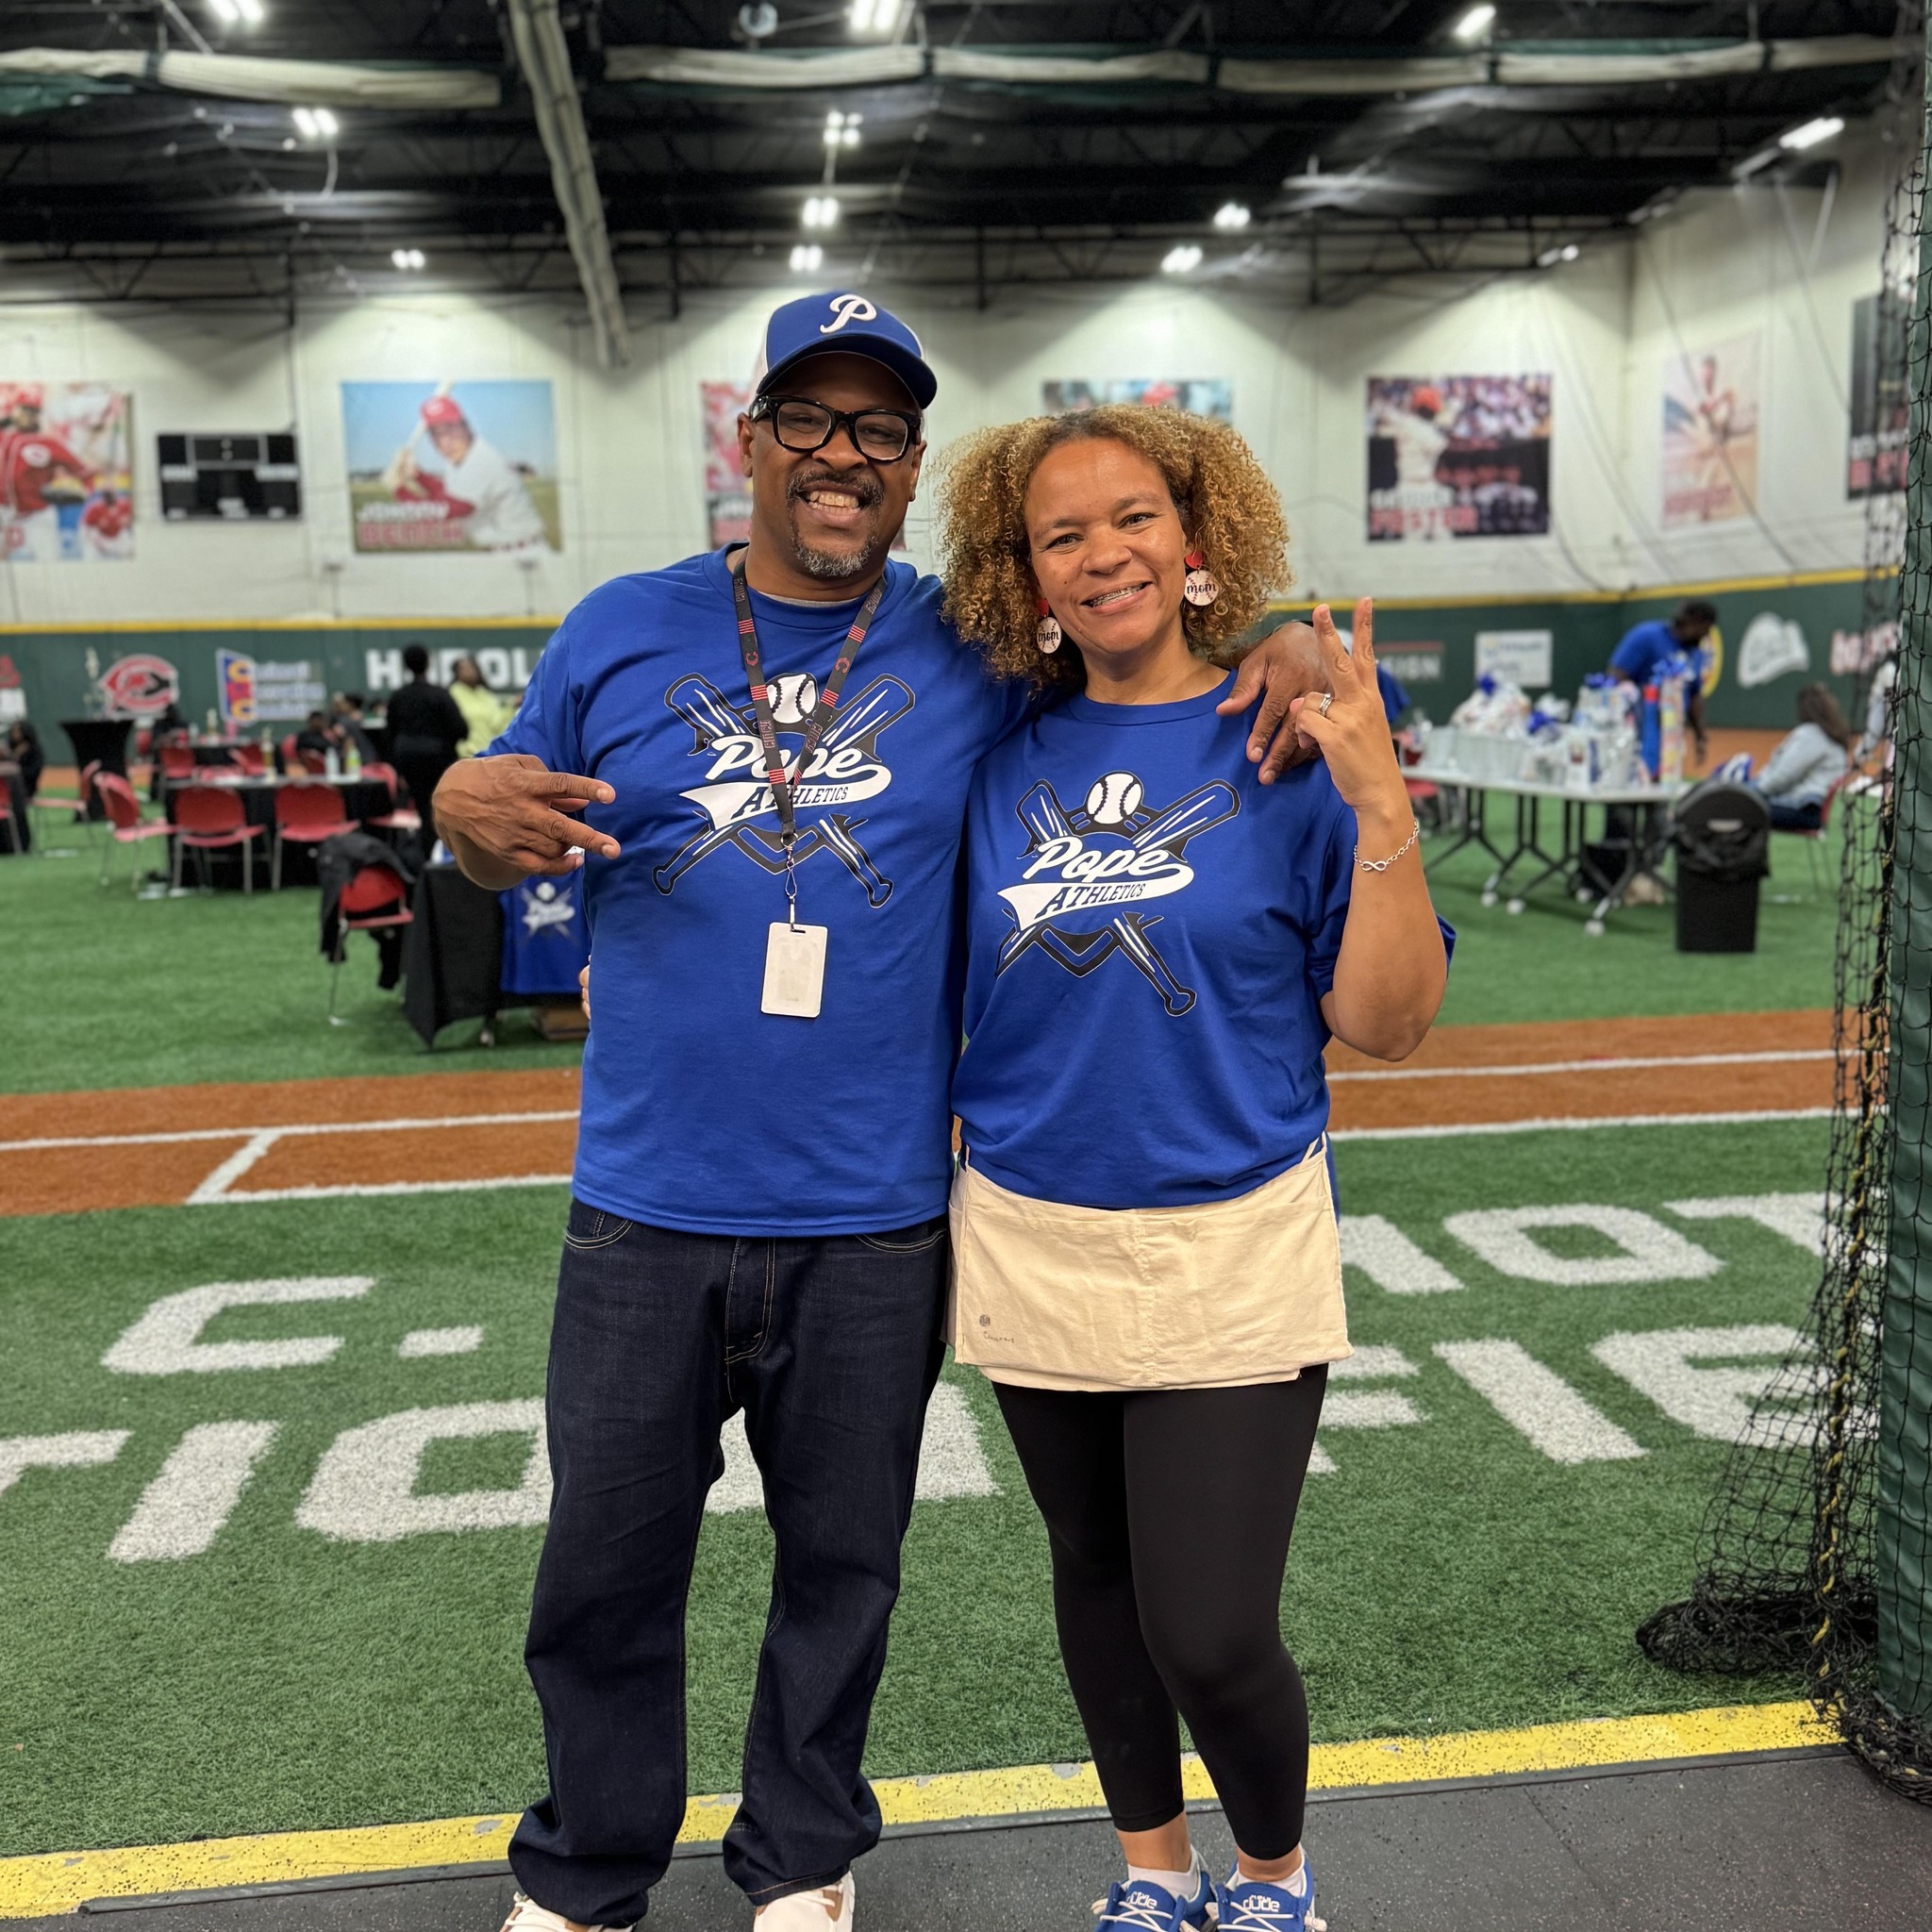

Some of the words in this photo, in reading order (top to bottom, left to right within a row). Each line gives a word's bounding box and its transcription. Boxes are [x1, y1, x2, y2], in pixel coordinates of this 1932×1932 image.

[820, 293, 876, 333] P
[1186, 583, 1217, 597] mom
[1022, 836, 1172, 884] Pope
[1034, 883, 1147, 920] ATHLETICS
